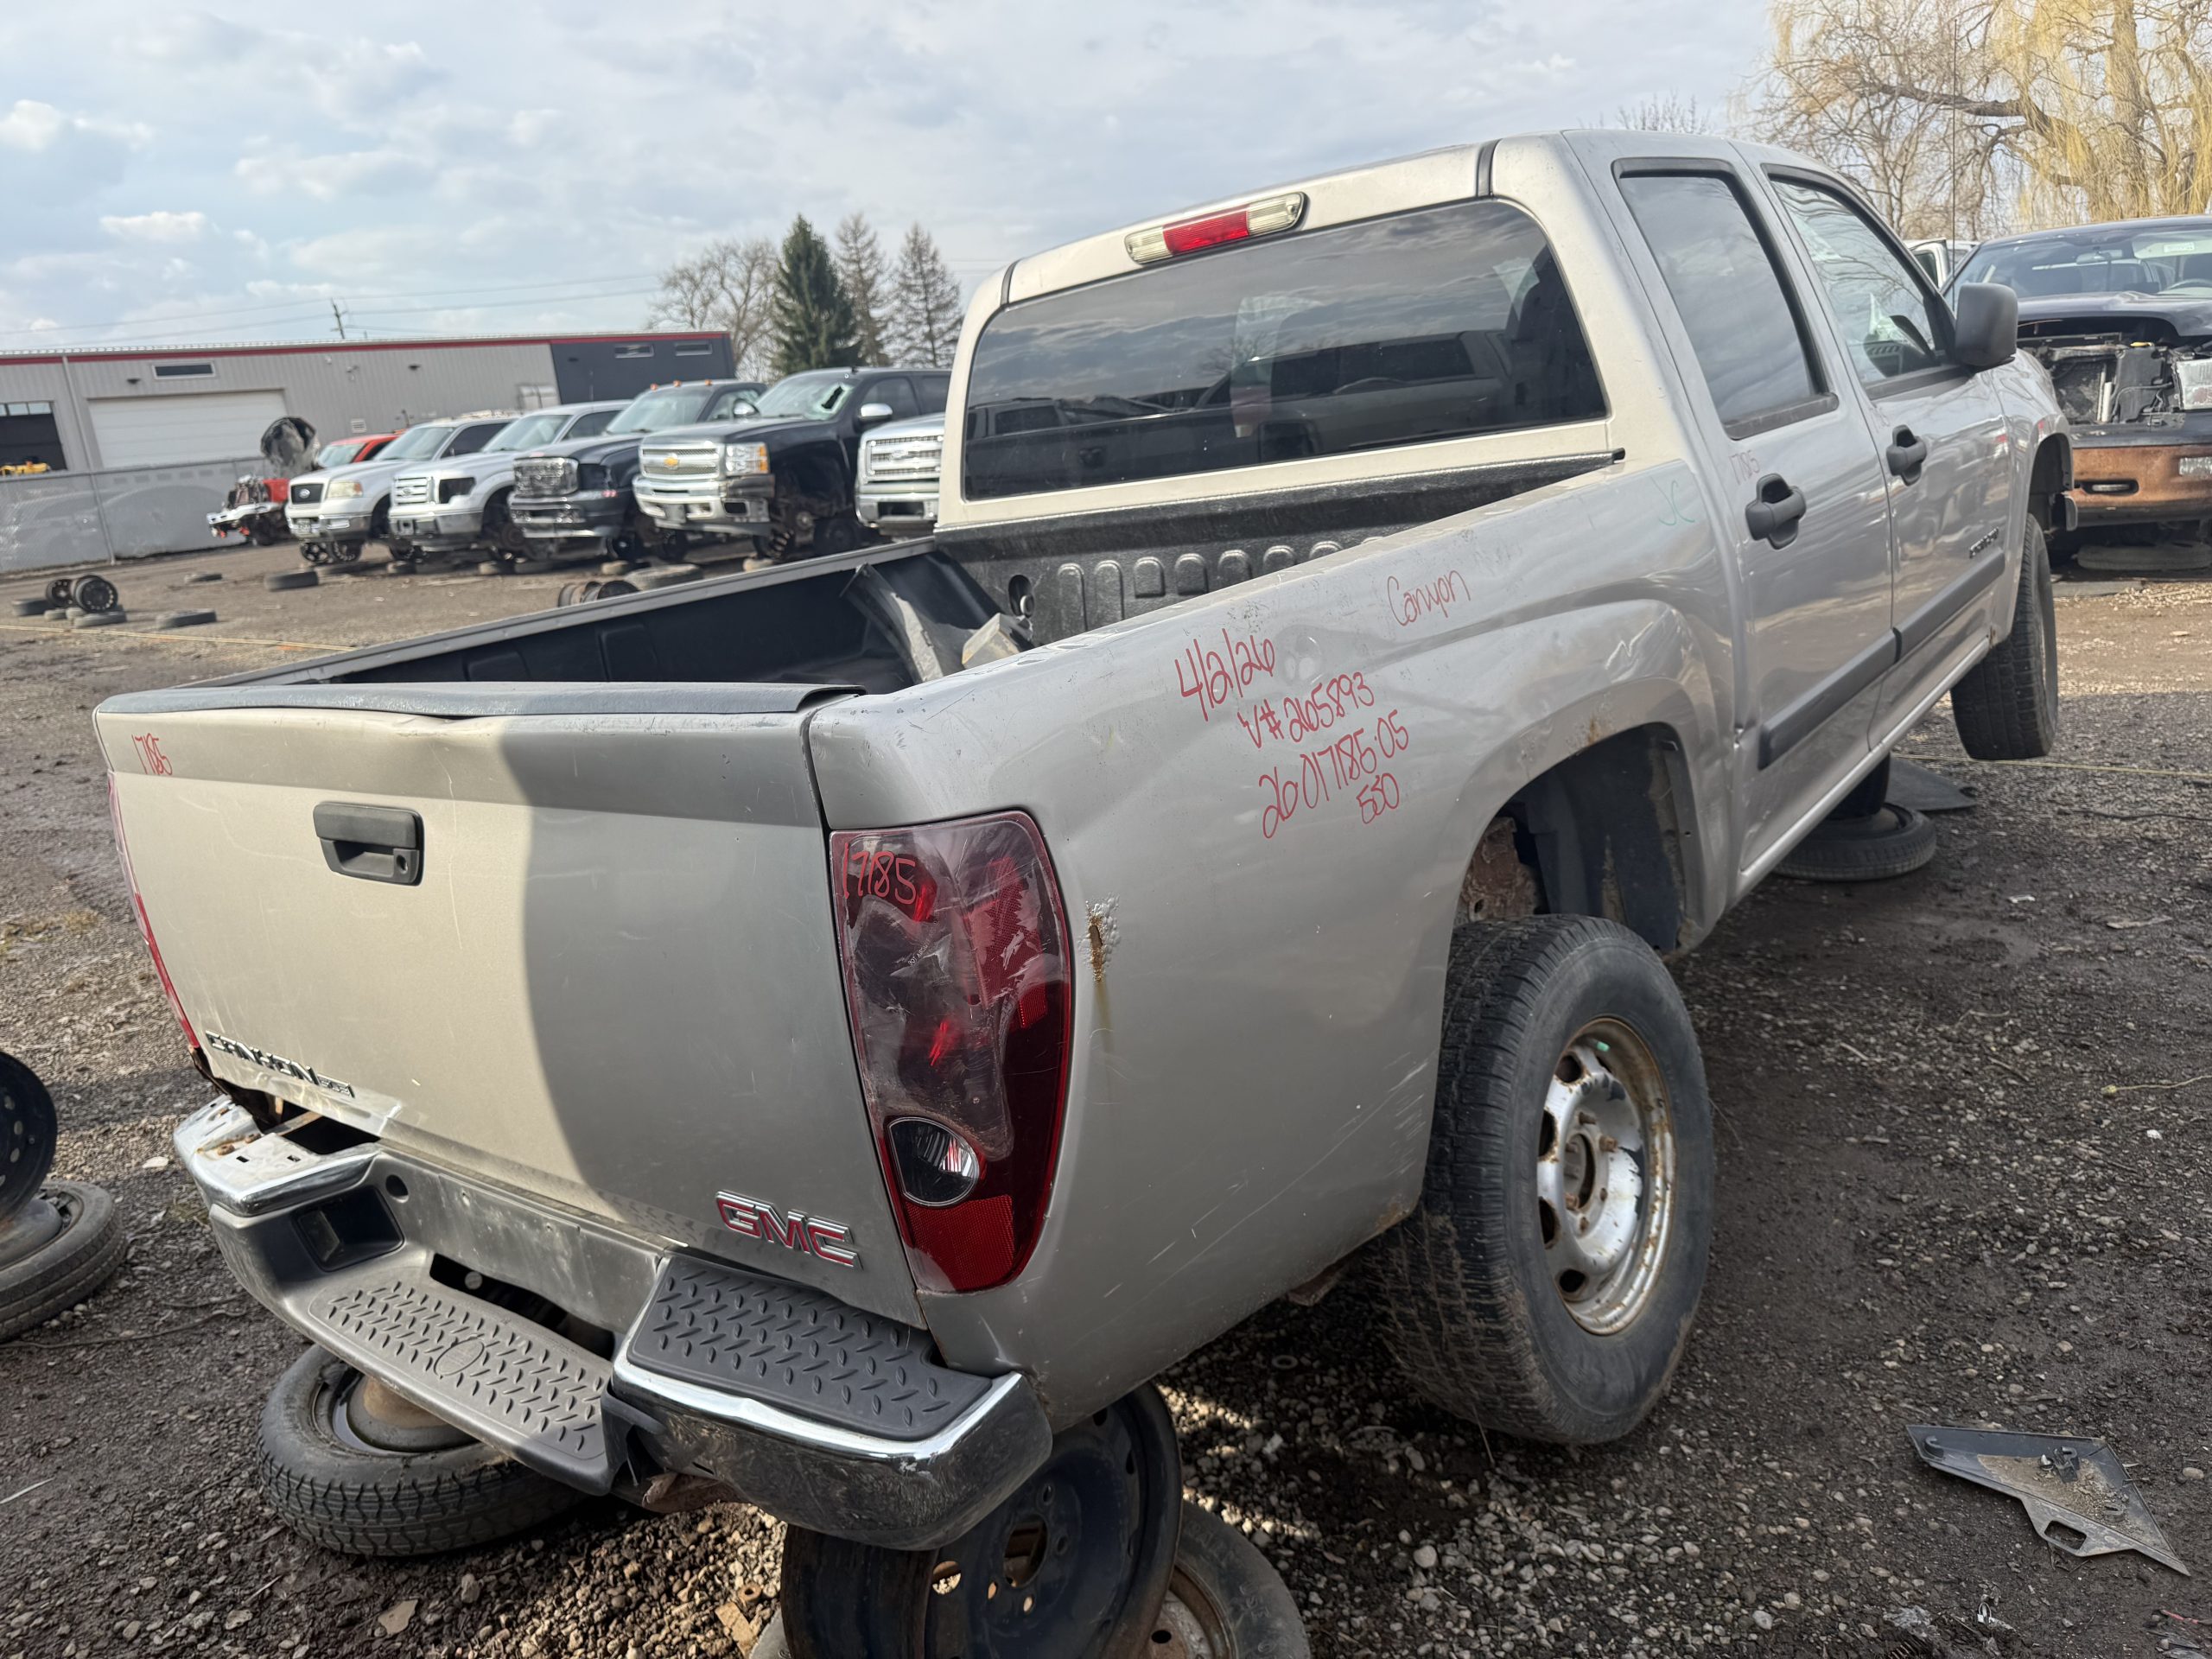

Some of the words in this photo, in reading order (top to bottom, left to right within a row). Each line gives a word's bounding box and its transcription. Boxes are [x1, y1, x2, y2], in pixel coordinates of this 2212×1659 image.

[1387, 570, 1471, 626] Canyon
[1174, 627, 1274, 721] 4/2/26
[715, 1189, 864, 1270] GMC
